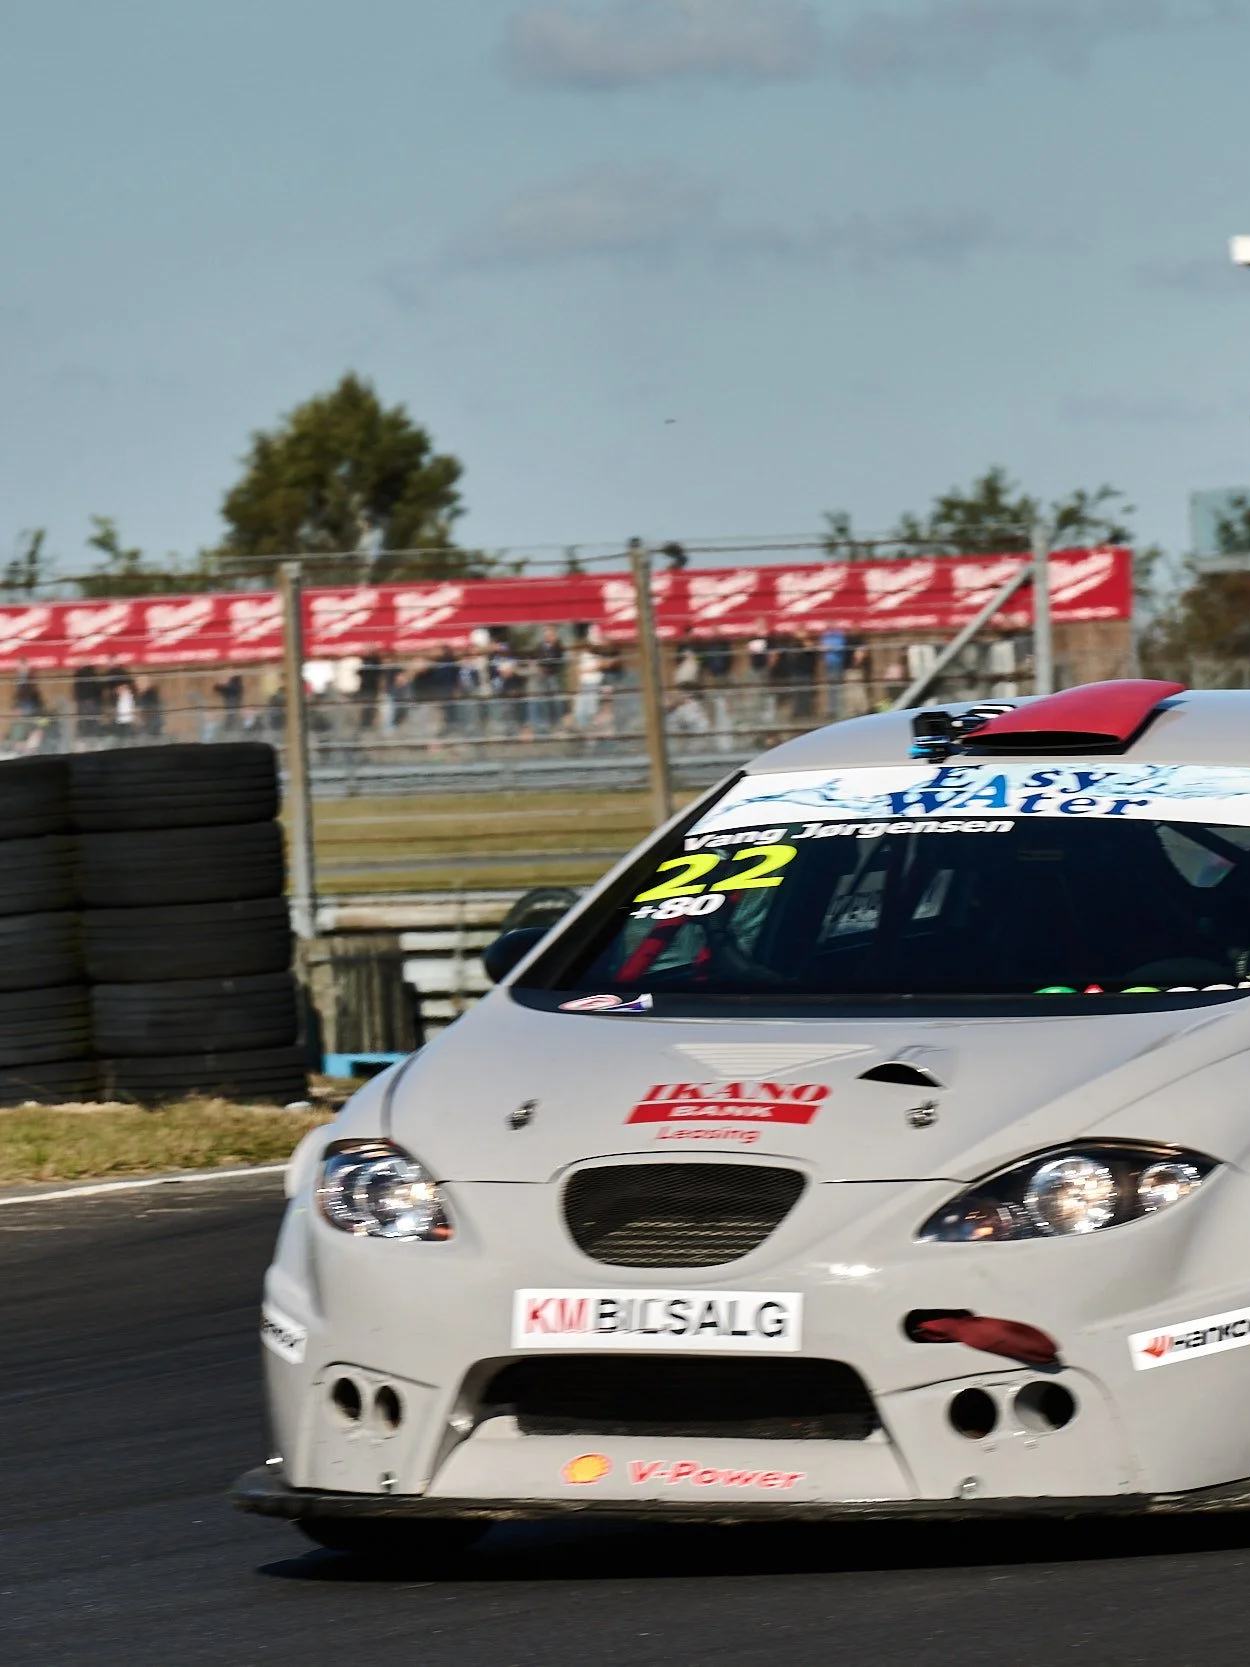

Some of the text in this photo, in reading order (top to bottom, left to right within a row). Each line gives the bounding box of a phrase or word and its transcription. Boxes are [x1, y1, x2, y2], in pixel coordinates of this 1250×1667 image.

[683, 819, 1015, 851] Vang Jørgensen
[632, 844, 798, 903] 22
[629, 893, 727, 920] +80
[638, 1081, 833, 1102] IKANO
[667, 1104, 776, 1118] BANK
[655, 1125, 761, 1144] Leasing
[626, 1459, 808, 1490] V-Power
